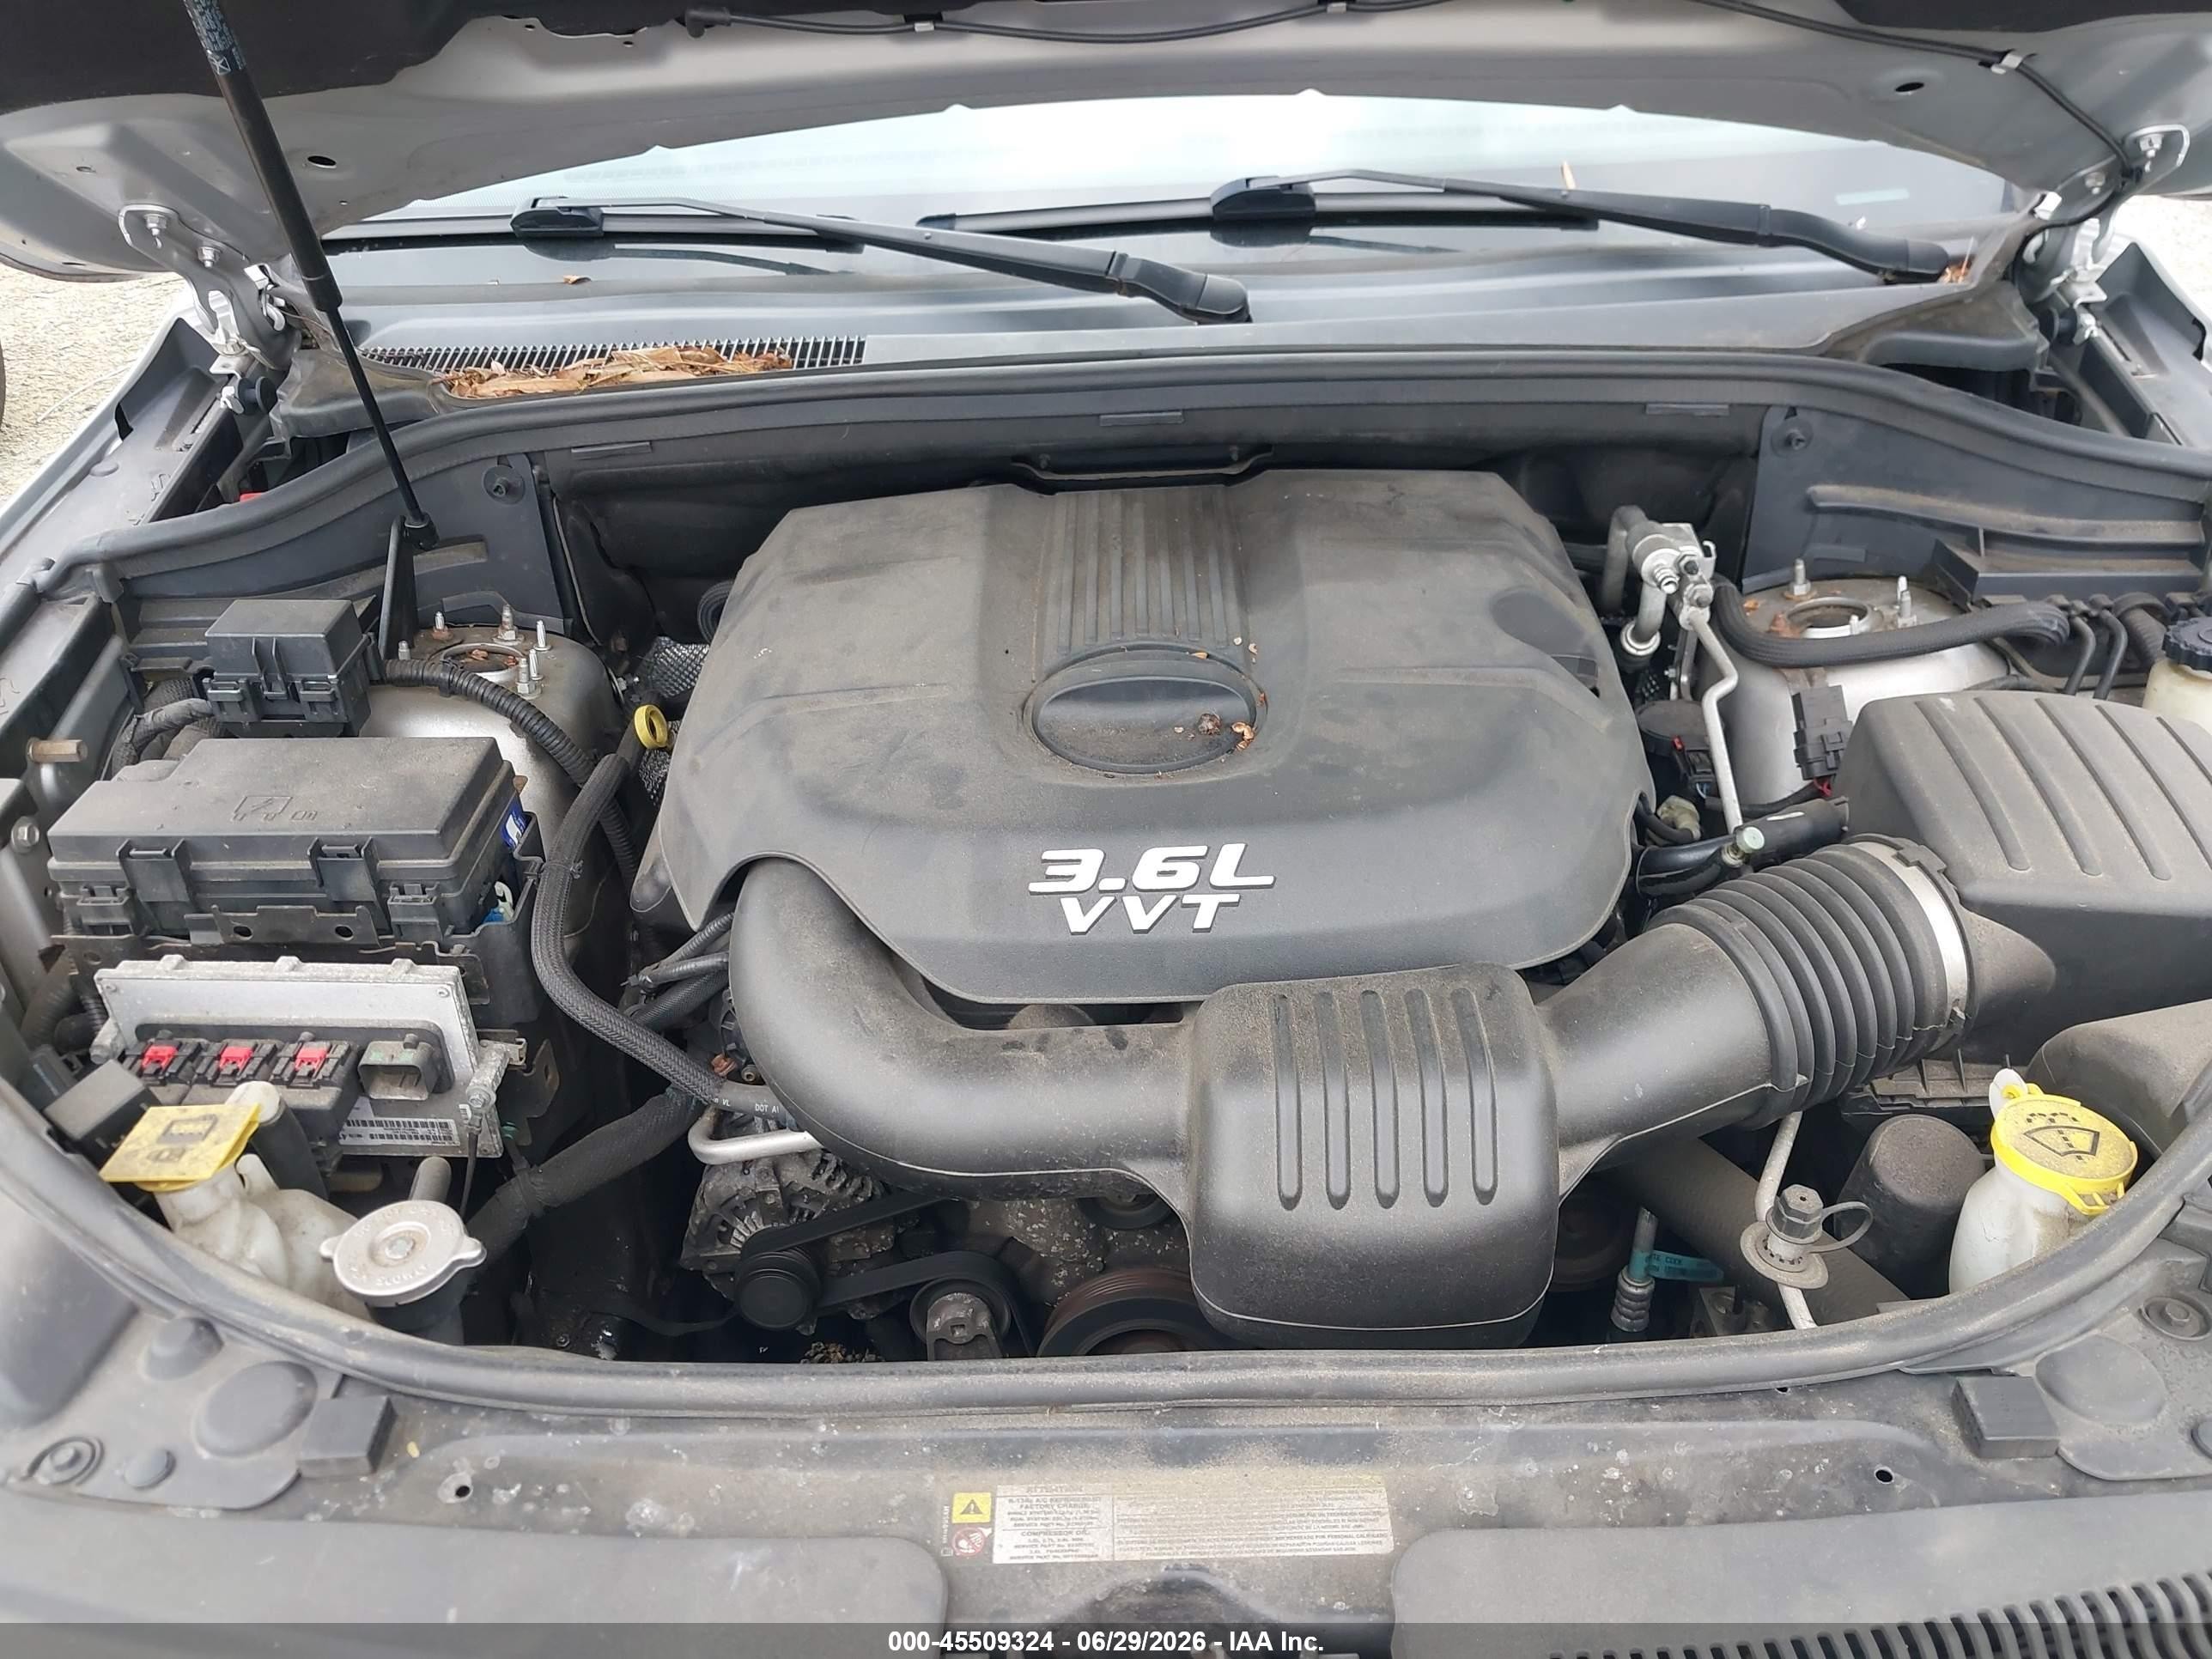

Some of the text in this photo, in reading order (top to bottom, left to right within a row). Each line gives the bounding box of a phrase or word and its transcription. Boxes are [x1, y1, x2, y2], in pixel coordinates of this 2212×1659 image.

[1028, 842, 1276, 896] 3.6L
[1060, 893, 1241, 935] VVT
[755, 1103, 769, 1112] DOT
